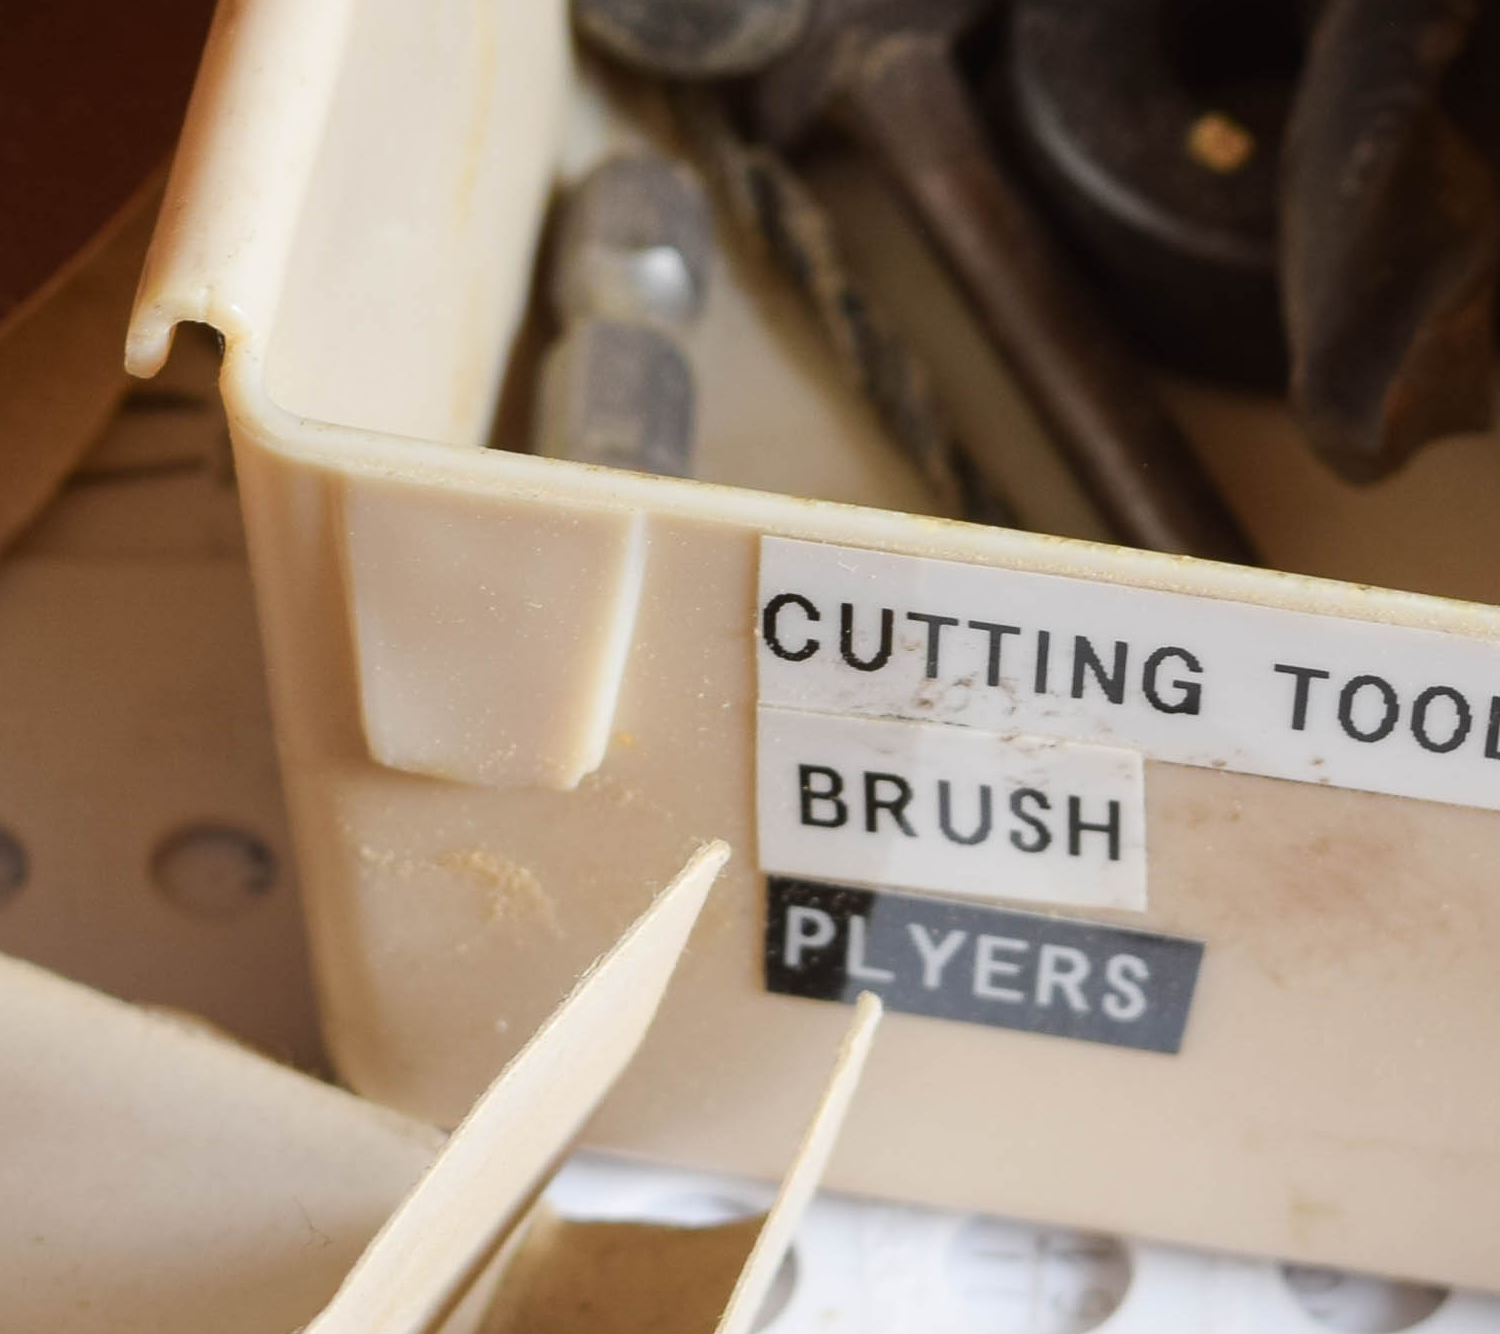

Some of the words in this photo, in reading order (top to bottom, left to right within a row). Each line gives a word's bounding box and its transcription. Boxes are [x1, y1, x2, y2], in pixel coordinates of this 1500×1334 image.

[762, 592, 1204, 716] CUTTING
[798, 763, 1121, 861] BRUSH
[781, 905, 1152, 1023] PLYERS
